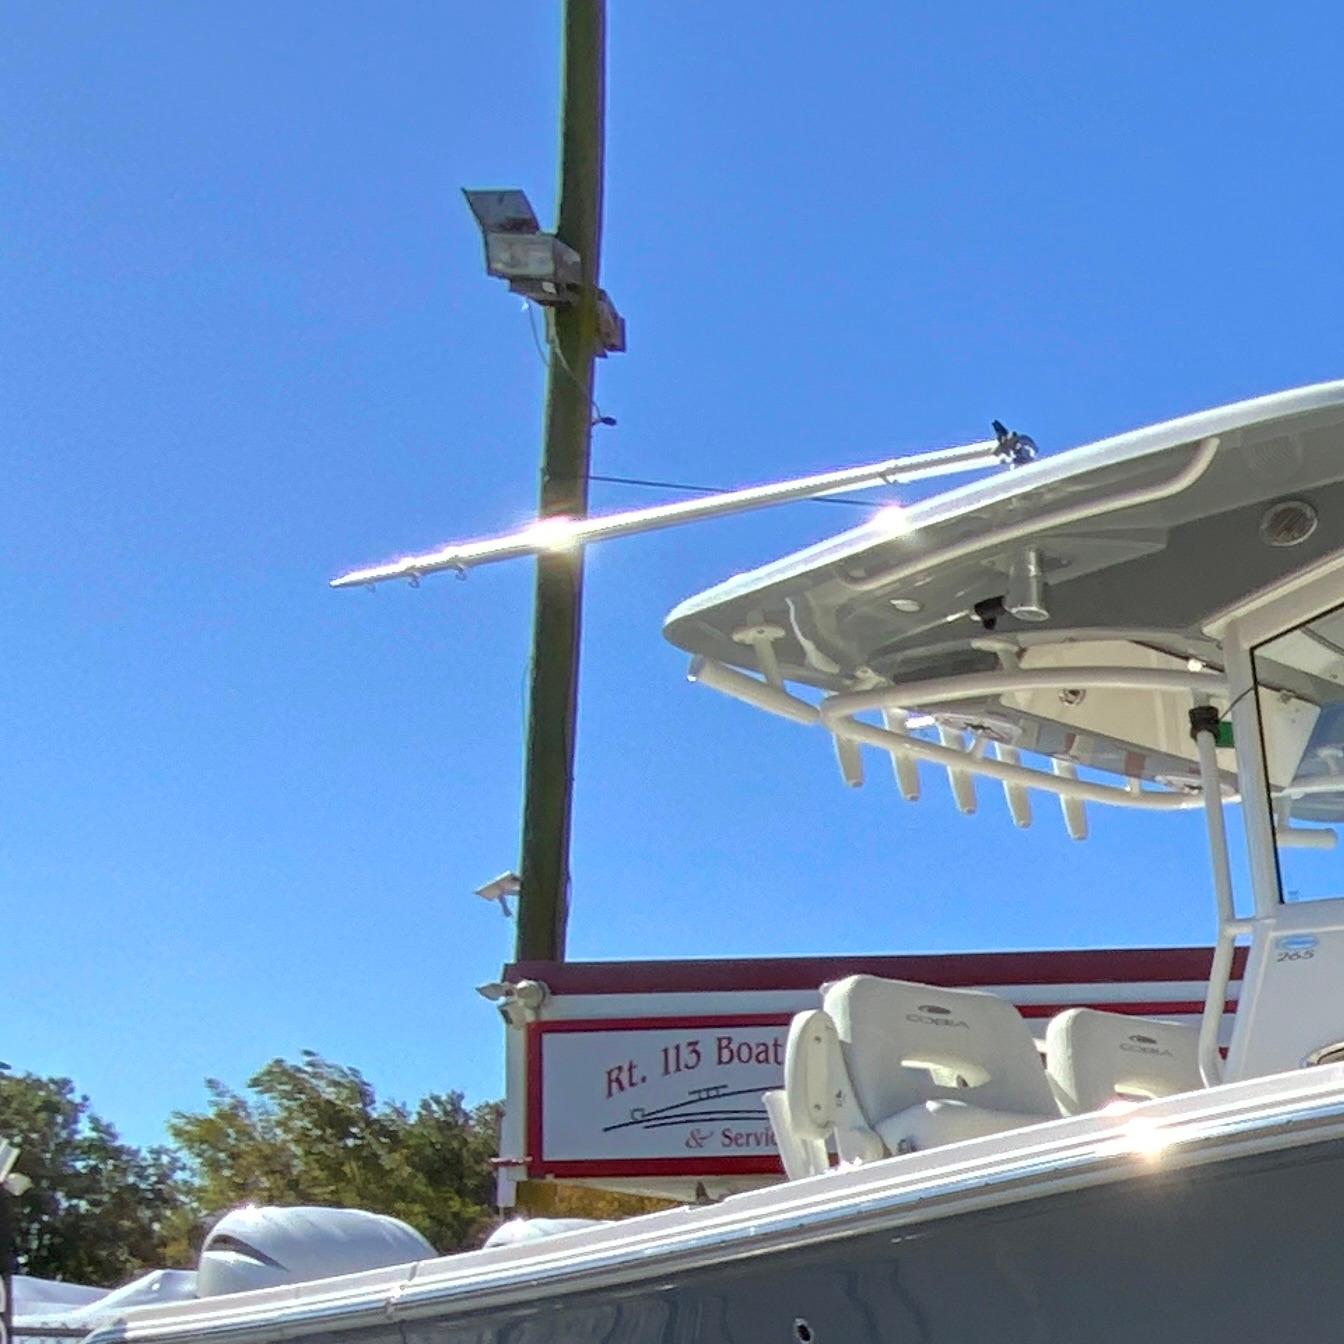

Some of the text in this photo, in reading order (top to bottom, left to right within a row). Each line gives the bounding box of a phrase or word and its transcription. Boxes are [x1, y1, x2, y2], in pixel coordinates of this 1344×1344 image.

[605, 1036, 784, 1098] Rt. 113 Boat
[685, 1127, 714, 1149] &
